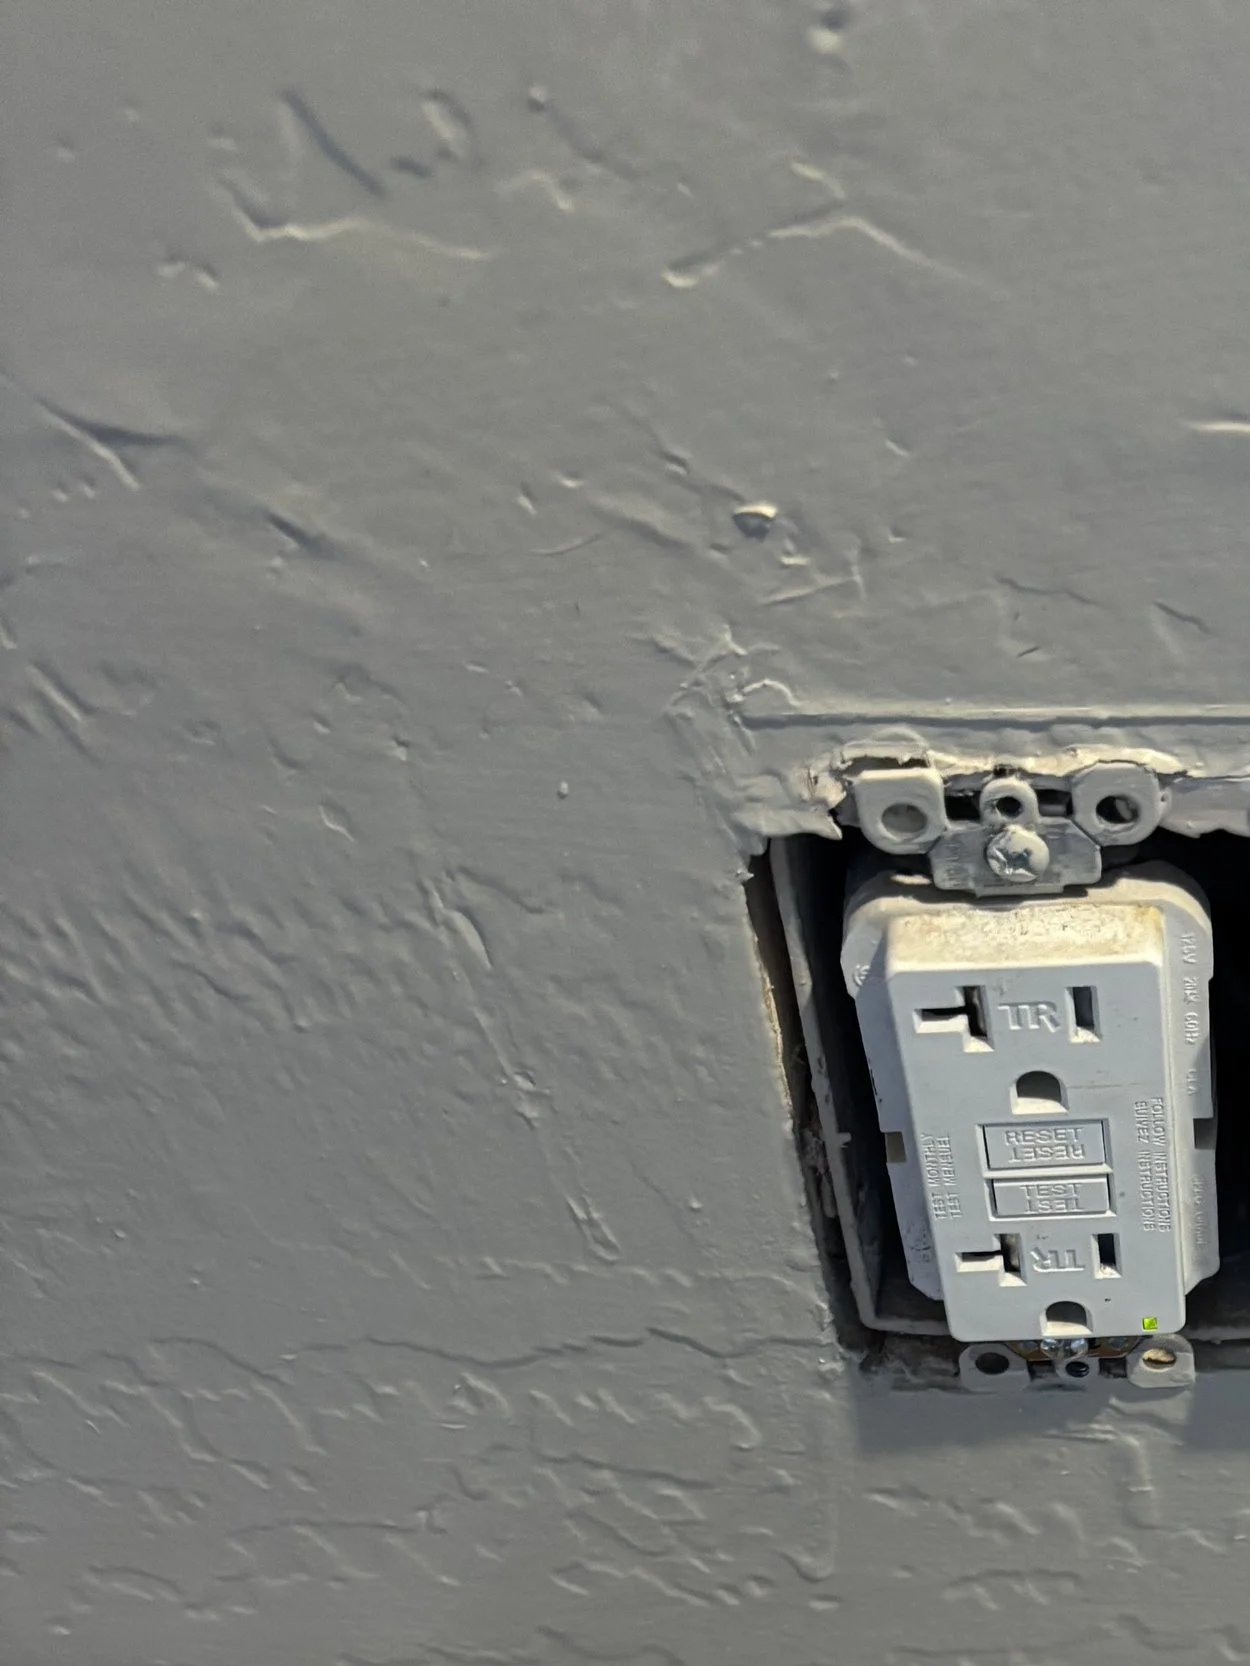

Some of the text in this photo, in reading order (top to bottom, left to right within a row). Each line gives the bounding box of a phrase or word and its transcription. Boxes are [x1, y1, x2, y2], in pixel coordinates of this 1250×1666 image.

[997, 1001, 1061, 1033] TR
[1004, 1127, 1084, 1146] RESET
[1008, 1143, 1086, 1163] RESET
[1134, 1100, 1157, 1232] SUIVEZ INSTRUCTIONS
[1151, 1097, 1173, 1233] FOLLOW INSTRUCTIONS
[920, 1132, 949, 1221] TEST MONTHLY
[936, 1132, 963, 1220] TEST MENSUEL
[1020, 1183, 1082, 1200] TEST
[1023, 1198, 1084, 1214] TEST
[1029, 1246, 1086, 1273] TR
